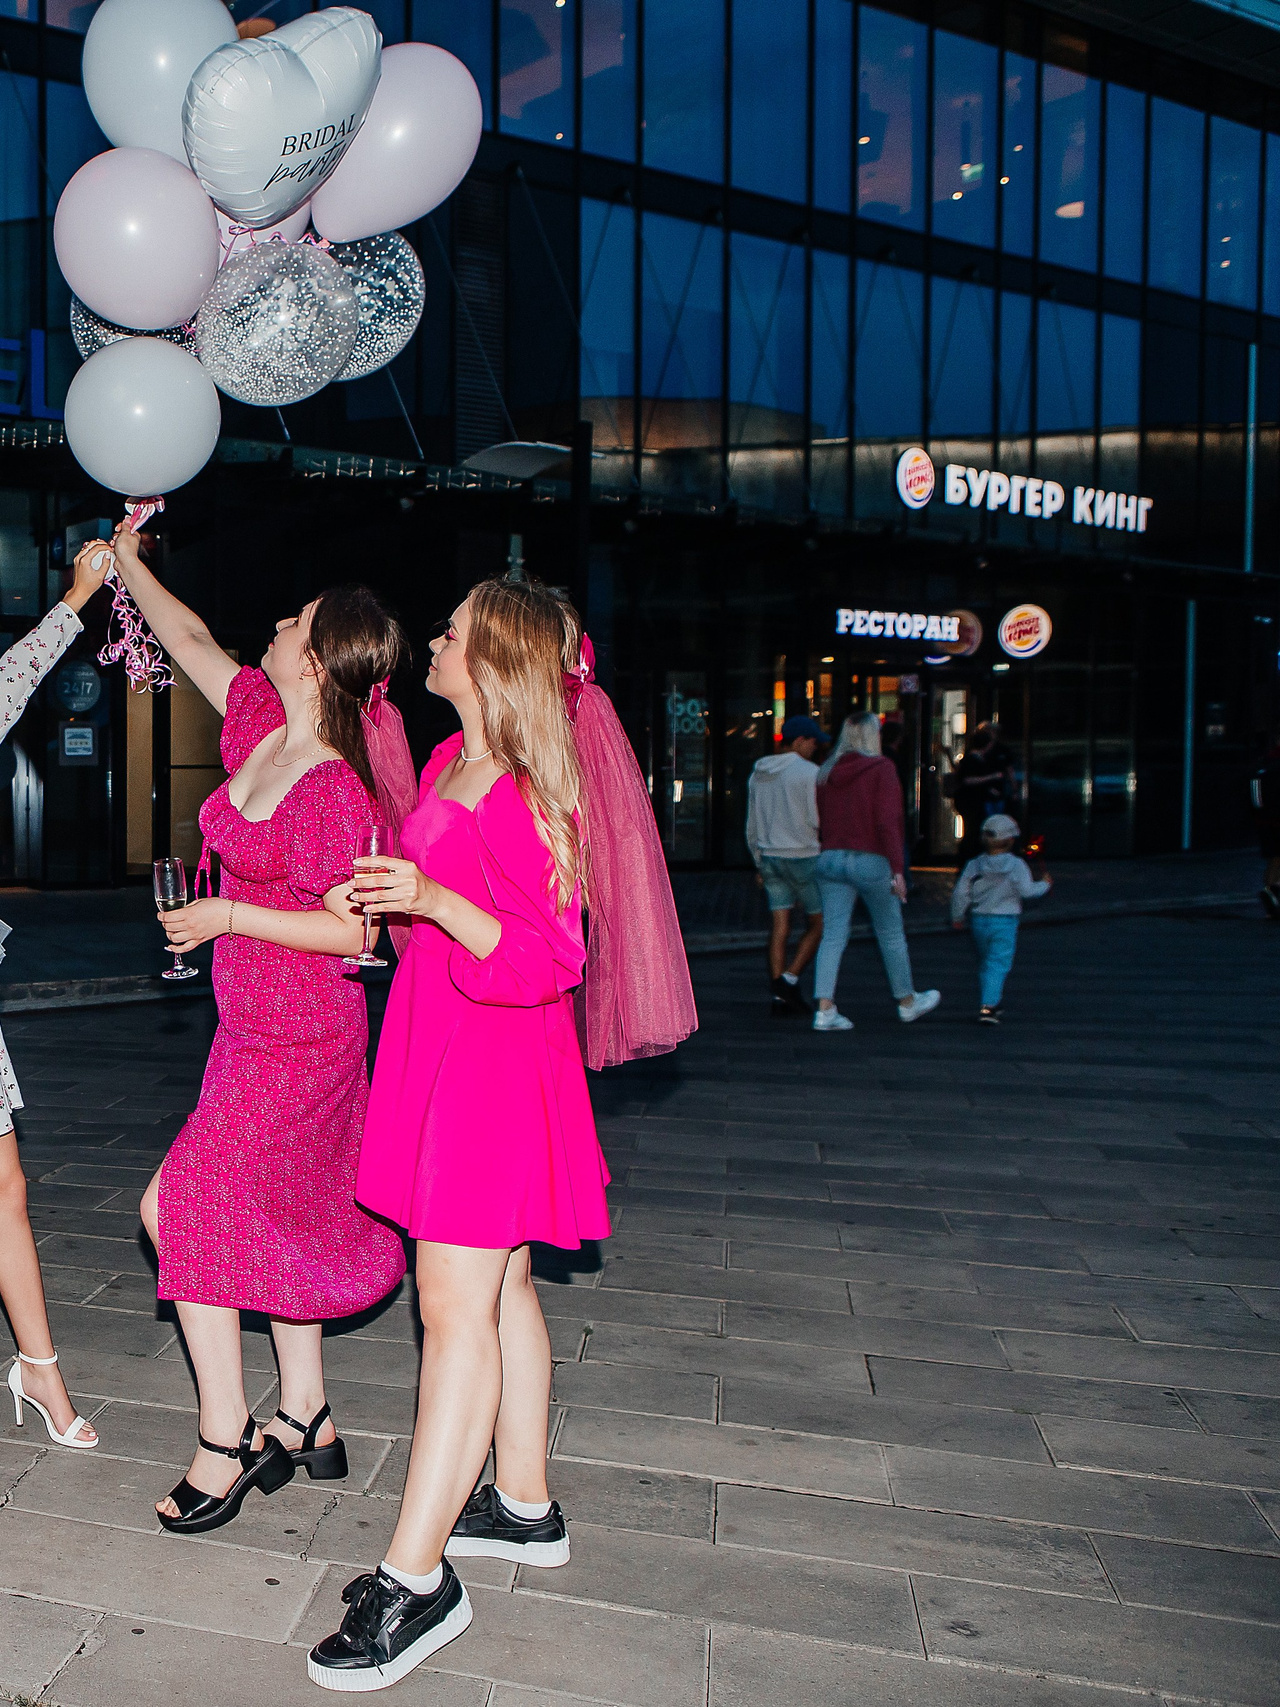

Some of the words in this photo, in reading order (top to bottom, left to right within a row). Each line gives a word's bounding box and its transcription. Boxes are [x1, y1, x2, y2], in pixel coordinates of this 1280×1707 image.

[280, 112, 356, 157] BRIDAL
[945, 463, 1065, 519] БУРГЕР
[1072, 485, 1154, 534] КИНГ
[835, 608, 961, 642] РЕСТОРАН
